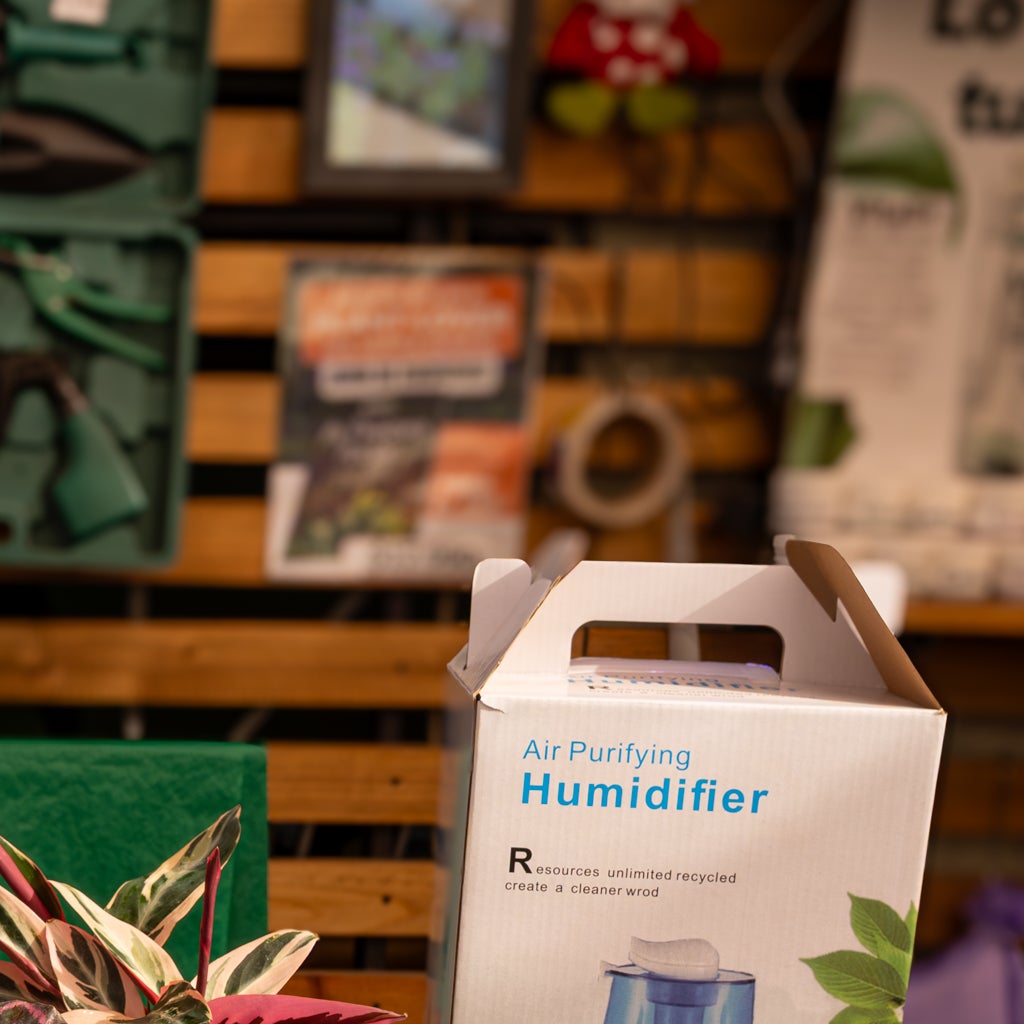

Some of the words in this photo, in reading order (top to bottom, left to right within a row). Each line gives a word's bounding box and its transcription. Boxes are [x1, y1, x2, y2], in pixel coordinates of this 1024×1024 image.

[523, 739, 561, 760] Air
[569, 741, 691, 770] Purifying
[521, 772, 769, 814] Humidifier
[607, 868, 672, 881] unlimited
[676, 870, 737, 884] recycled
[505, 881, 548, 893] create
[555, 883, 564, 893] a
[571, 882, 621, 896] cleaner
[626, 885, 659, 898] wrod
